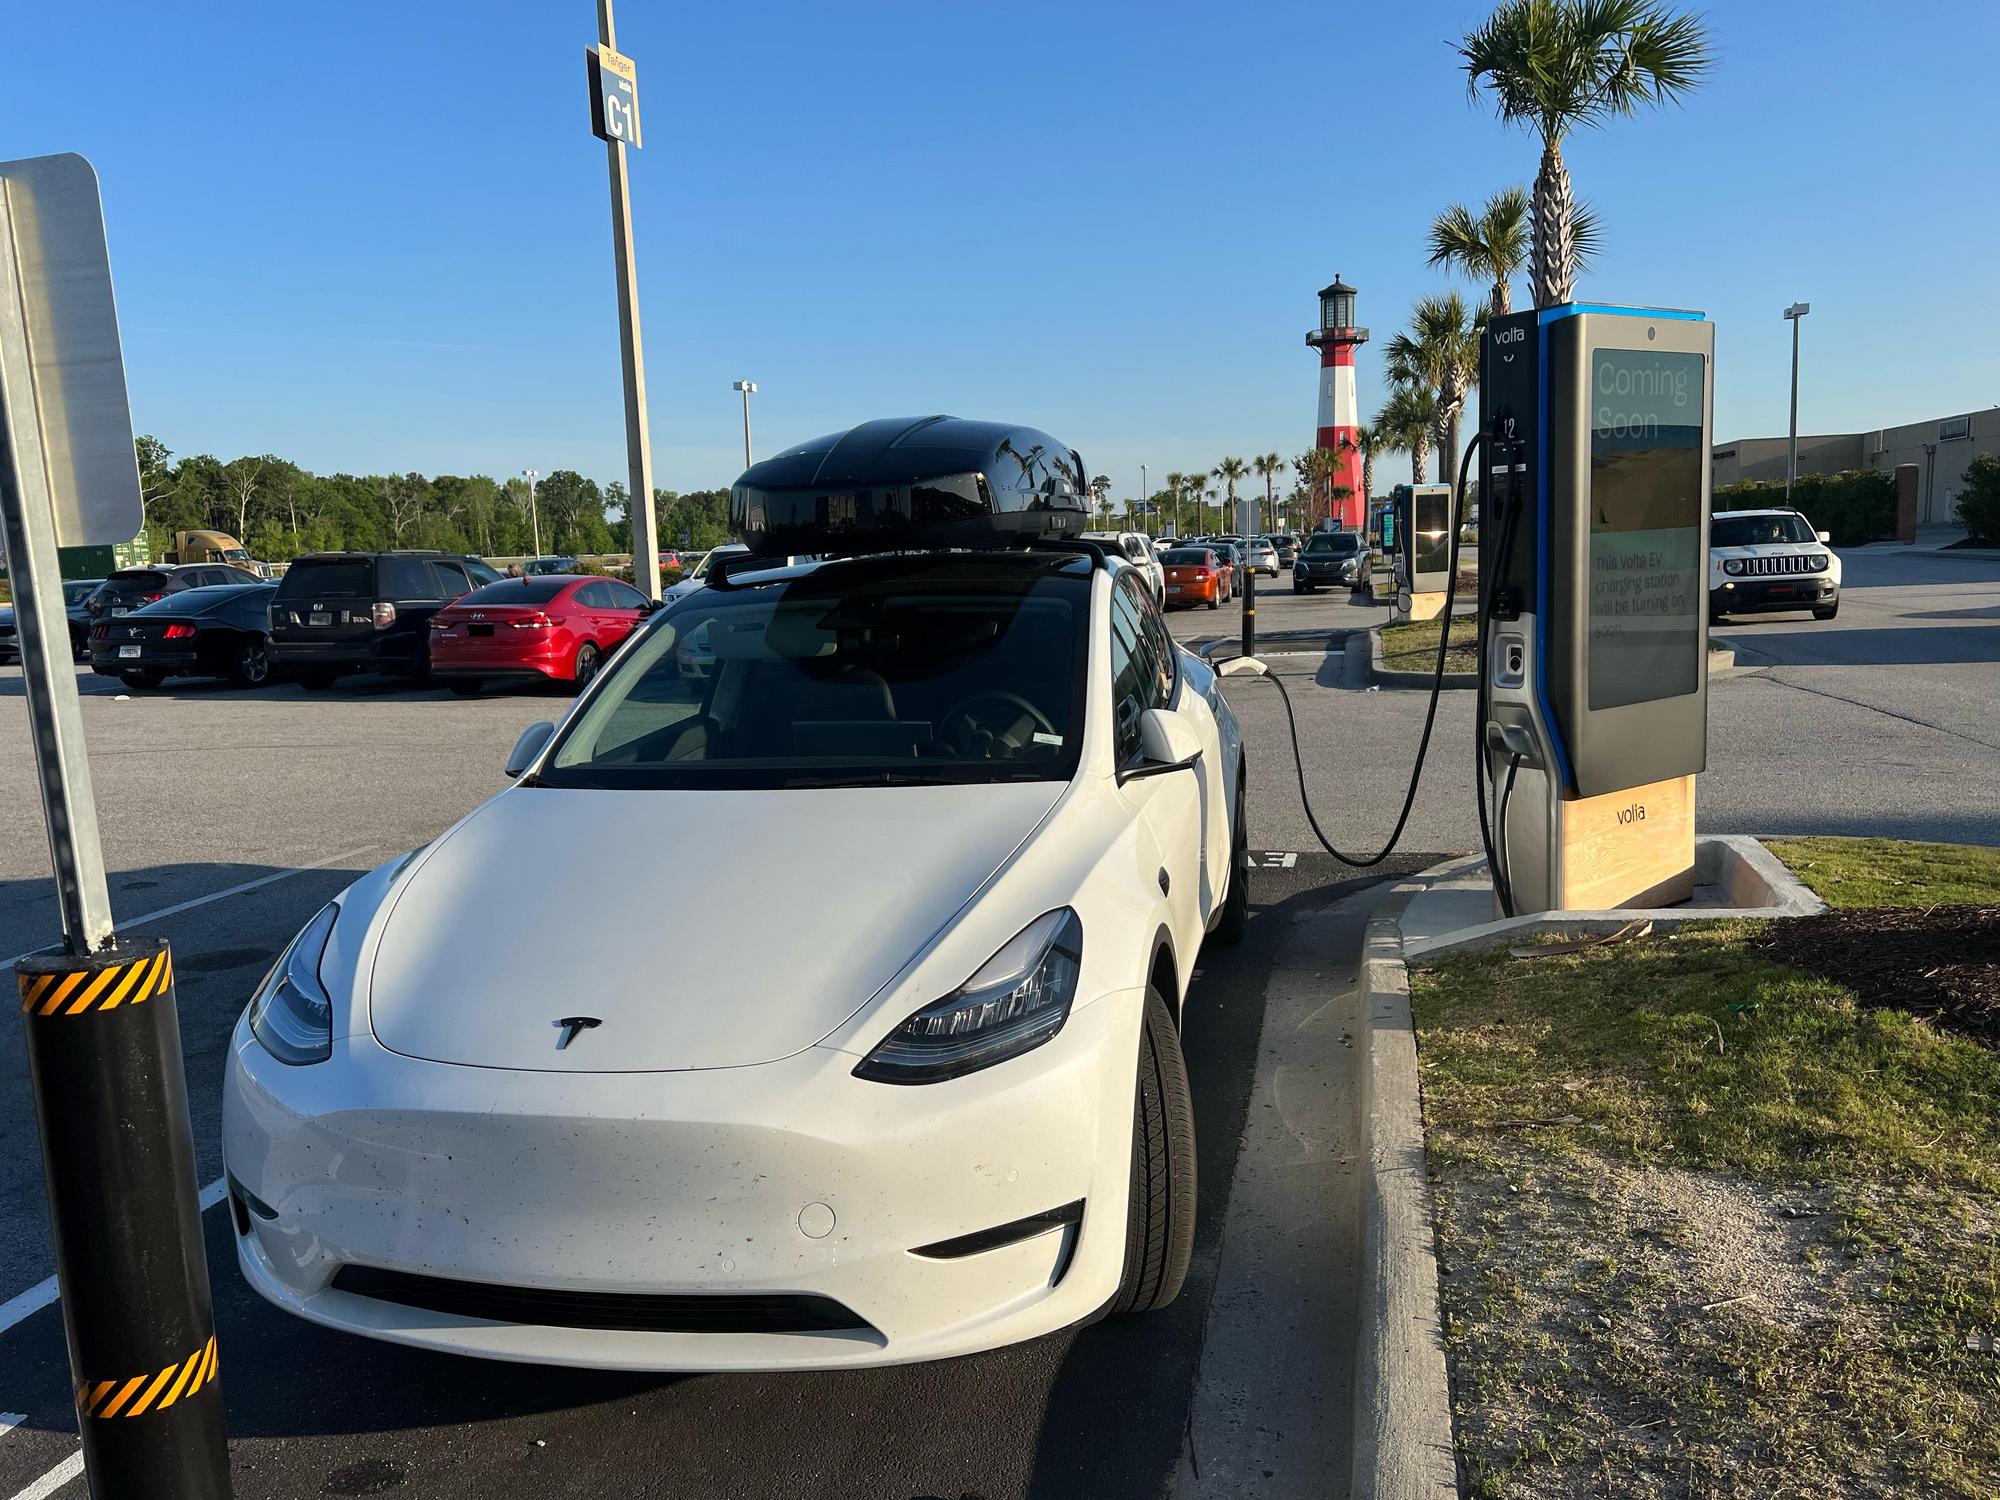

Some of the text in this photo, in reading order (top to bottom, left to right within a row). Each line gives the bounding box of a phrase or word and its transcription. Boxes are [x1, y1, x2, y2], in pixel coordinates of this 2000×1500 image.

[607, 94, 633, 142] C1
[1494, 326, 1525, 345] volta
[1599, 362, 1688, 406] Coming
[1503, 417, 1515, 439] 12
[1598, 406, 1659, 440] Soon
[1596, 551, 1663, 570] This Volta EV
[1595, 572, 1680, 595] charging station
[1594, 593, 1684, 616] will be turning on
